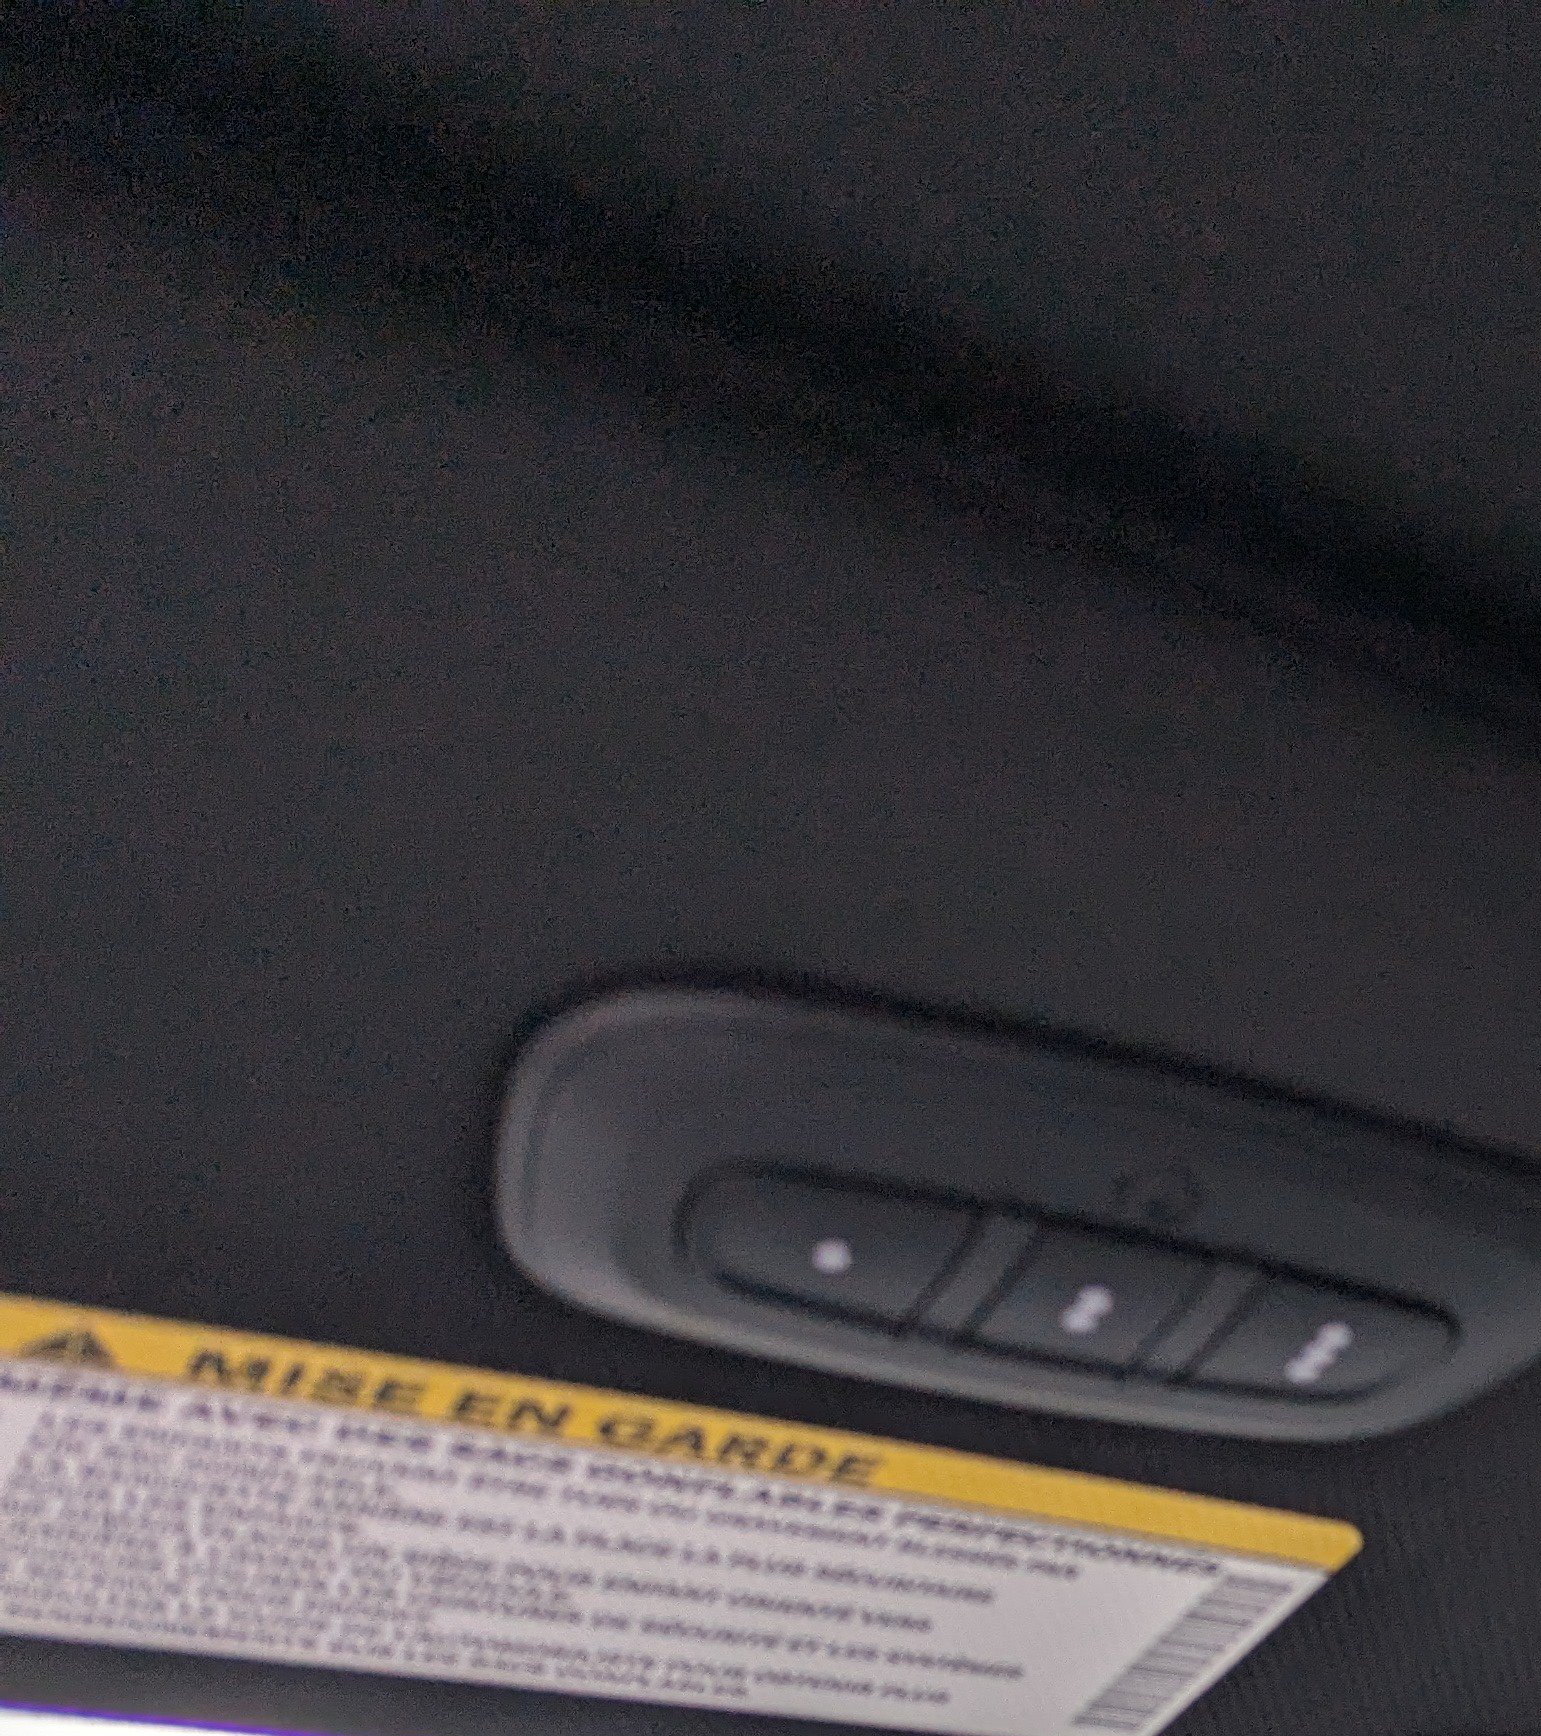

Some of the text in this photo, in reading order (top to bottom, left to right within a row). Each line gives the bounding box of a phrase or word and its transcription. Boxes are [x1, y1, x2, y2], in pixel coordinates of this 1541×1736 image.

[187, 1347, 883, 1489] MISE EN GARDE
